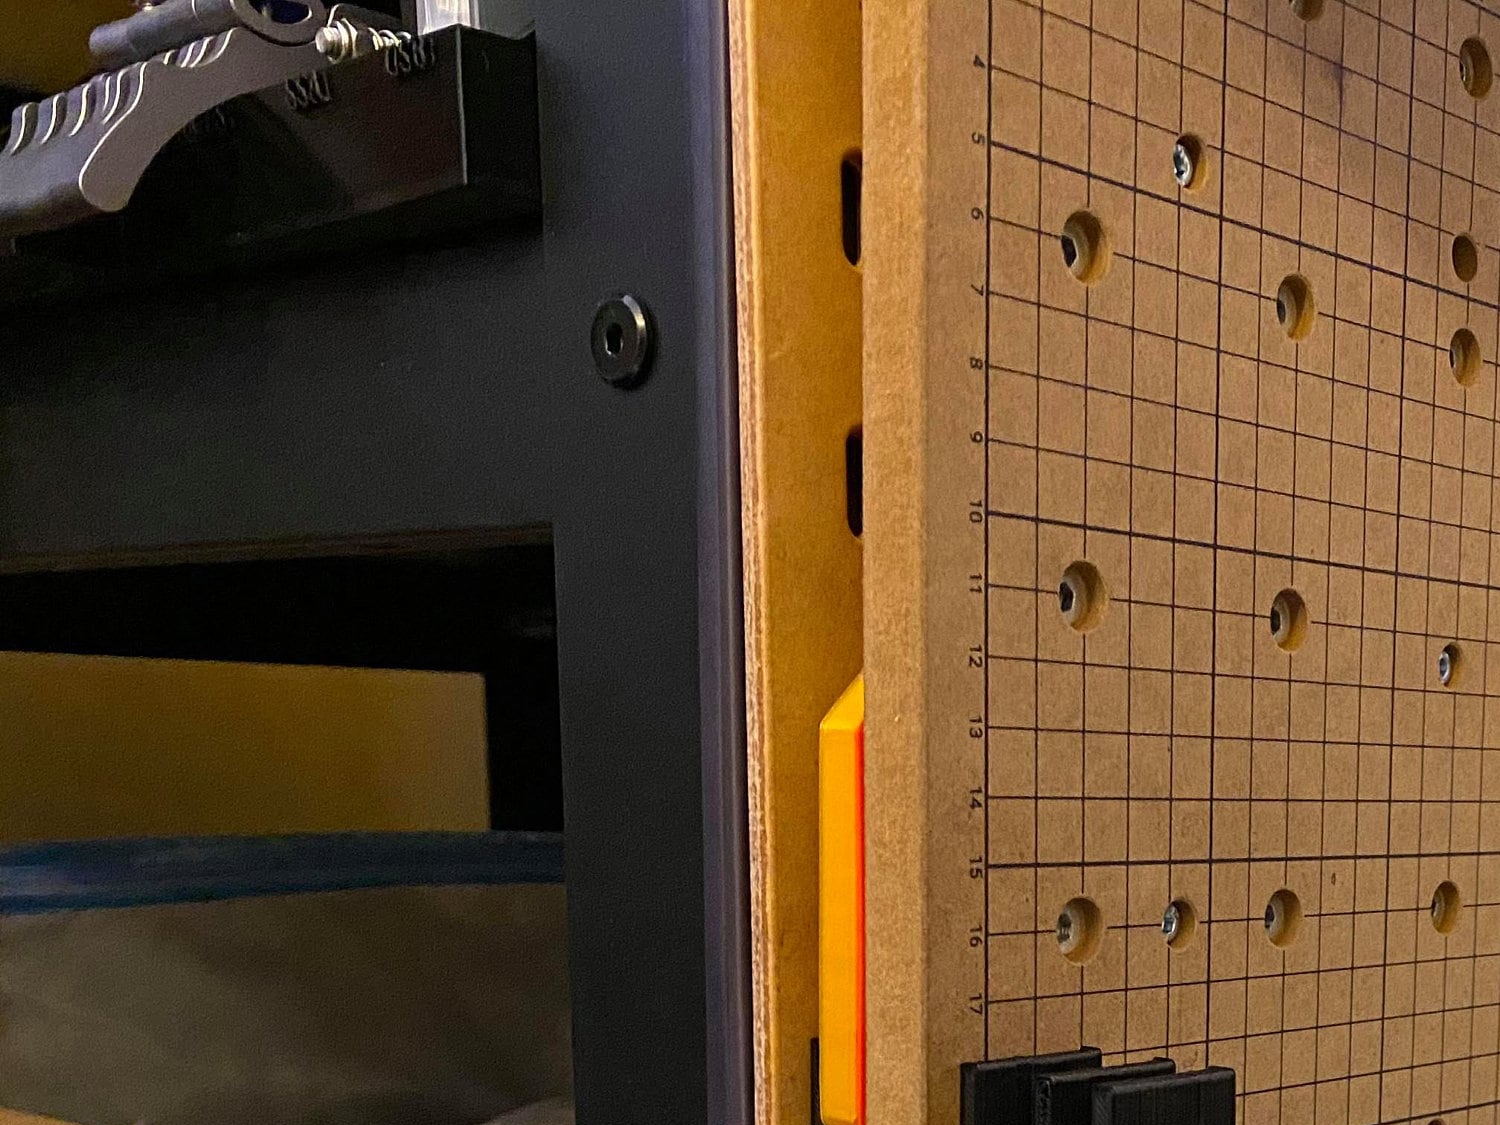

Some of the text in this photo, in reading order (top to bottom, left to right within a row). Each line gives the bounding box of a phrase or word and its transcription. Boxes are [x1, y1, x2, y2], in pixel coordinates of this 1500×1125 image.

[972, 54, 986, 68] 4
[971, 131, 985, 145] 5
[971, 207, 984, 221] 6
[970, 283, 984, 297] 7
[969, 357, 983, 370] 8
[969, 431, 983, 444] 9
[969, 500, 983, 524] 10
[969, 573, 983, 595] 11
[968, 645, 983, 668] 12
[969, 715, 983, 739] 13
[969, 786, 983, 810] 14
[969, 856, 983, 880] 15
[969, 925, 983, 948] 16
[969, 993, 983, 1016] 17
